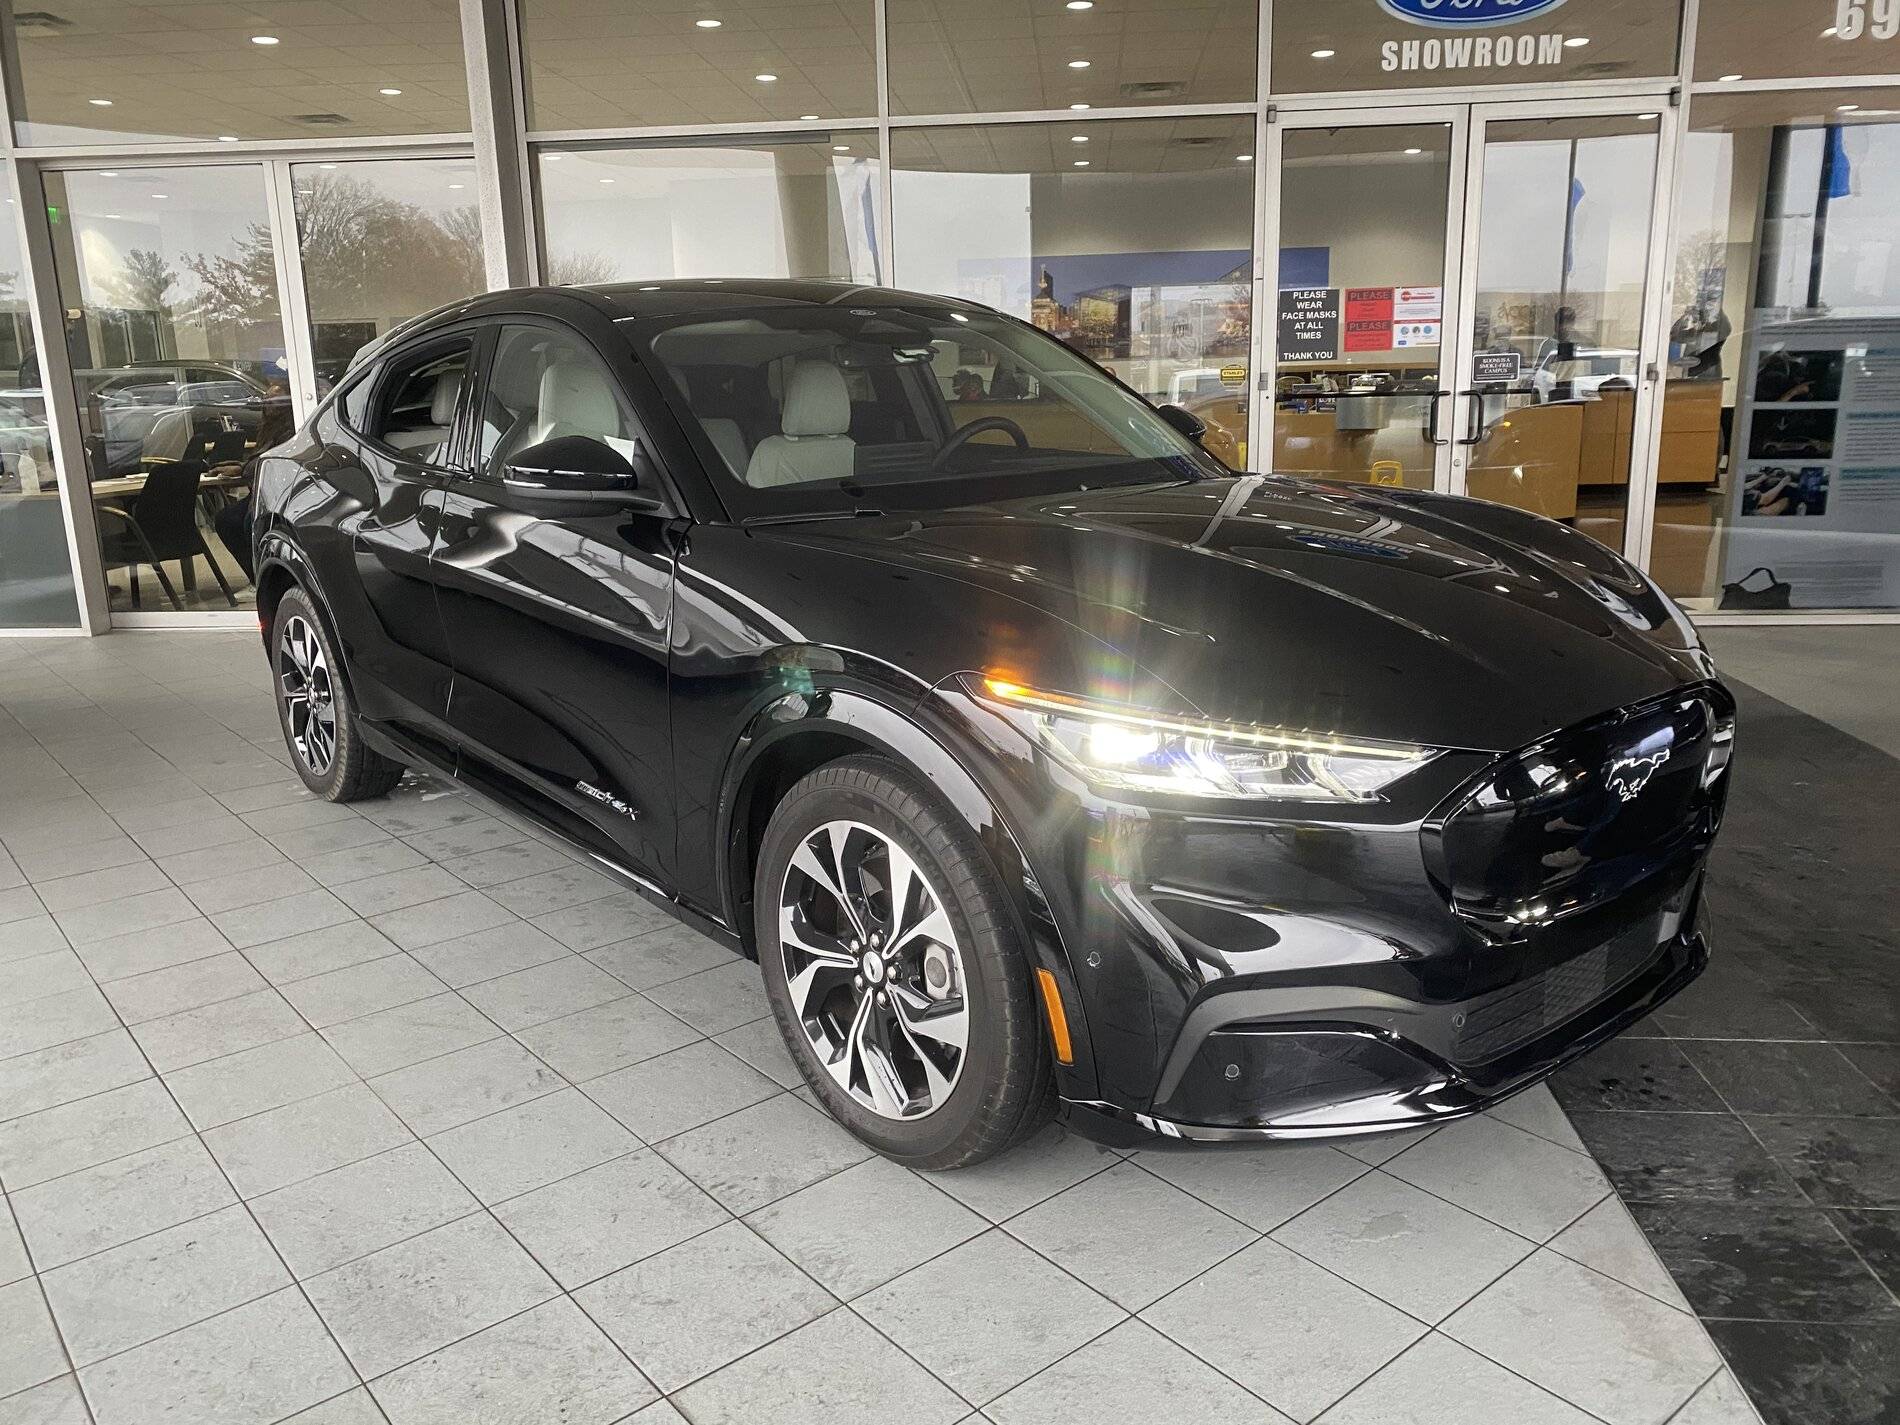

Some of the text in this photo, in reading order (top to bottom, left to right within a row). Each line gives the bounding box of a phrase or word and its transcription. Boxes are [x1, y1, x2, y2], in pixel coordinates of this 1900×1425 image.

[1381, 34, 1563, 72] SHOWROOM
[1293, 290, 1327, 300] PLEASE
[1350, 291, 1390, 301] PLEASE
[1296, 301, 1323, 309] WEAR
[1282, 310, 1337, 320] FACE MASKS
[1294, 321, 1324, 330] AT ALL
[1349, 322, 1388, 331] PLEASE
[1296, 331, 1322, 340] TIMES
[1283, 350, 1333, 360] THANK YOU
